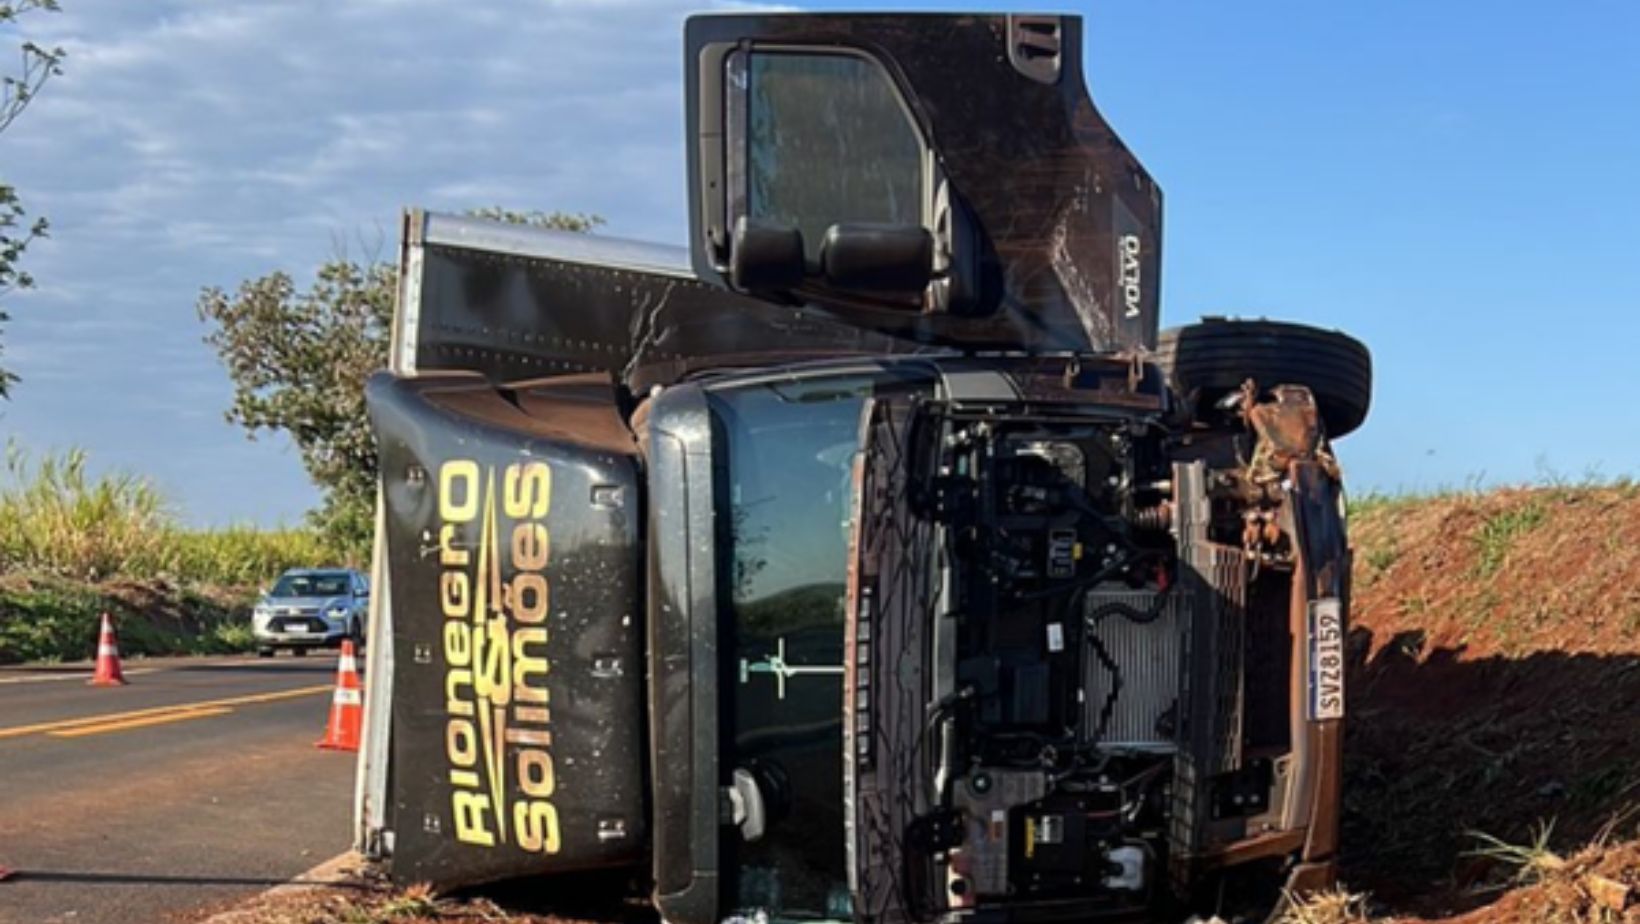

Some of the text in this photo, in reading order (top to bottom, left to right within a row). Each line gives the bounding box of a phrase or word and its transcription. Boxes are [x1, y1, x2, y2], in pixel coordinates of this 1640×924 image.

[1125, 235, 1140, 318] VOLVO
[473, 612, 512, 706] &
[1319, 614, 1340, 710] SVZ8159
